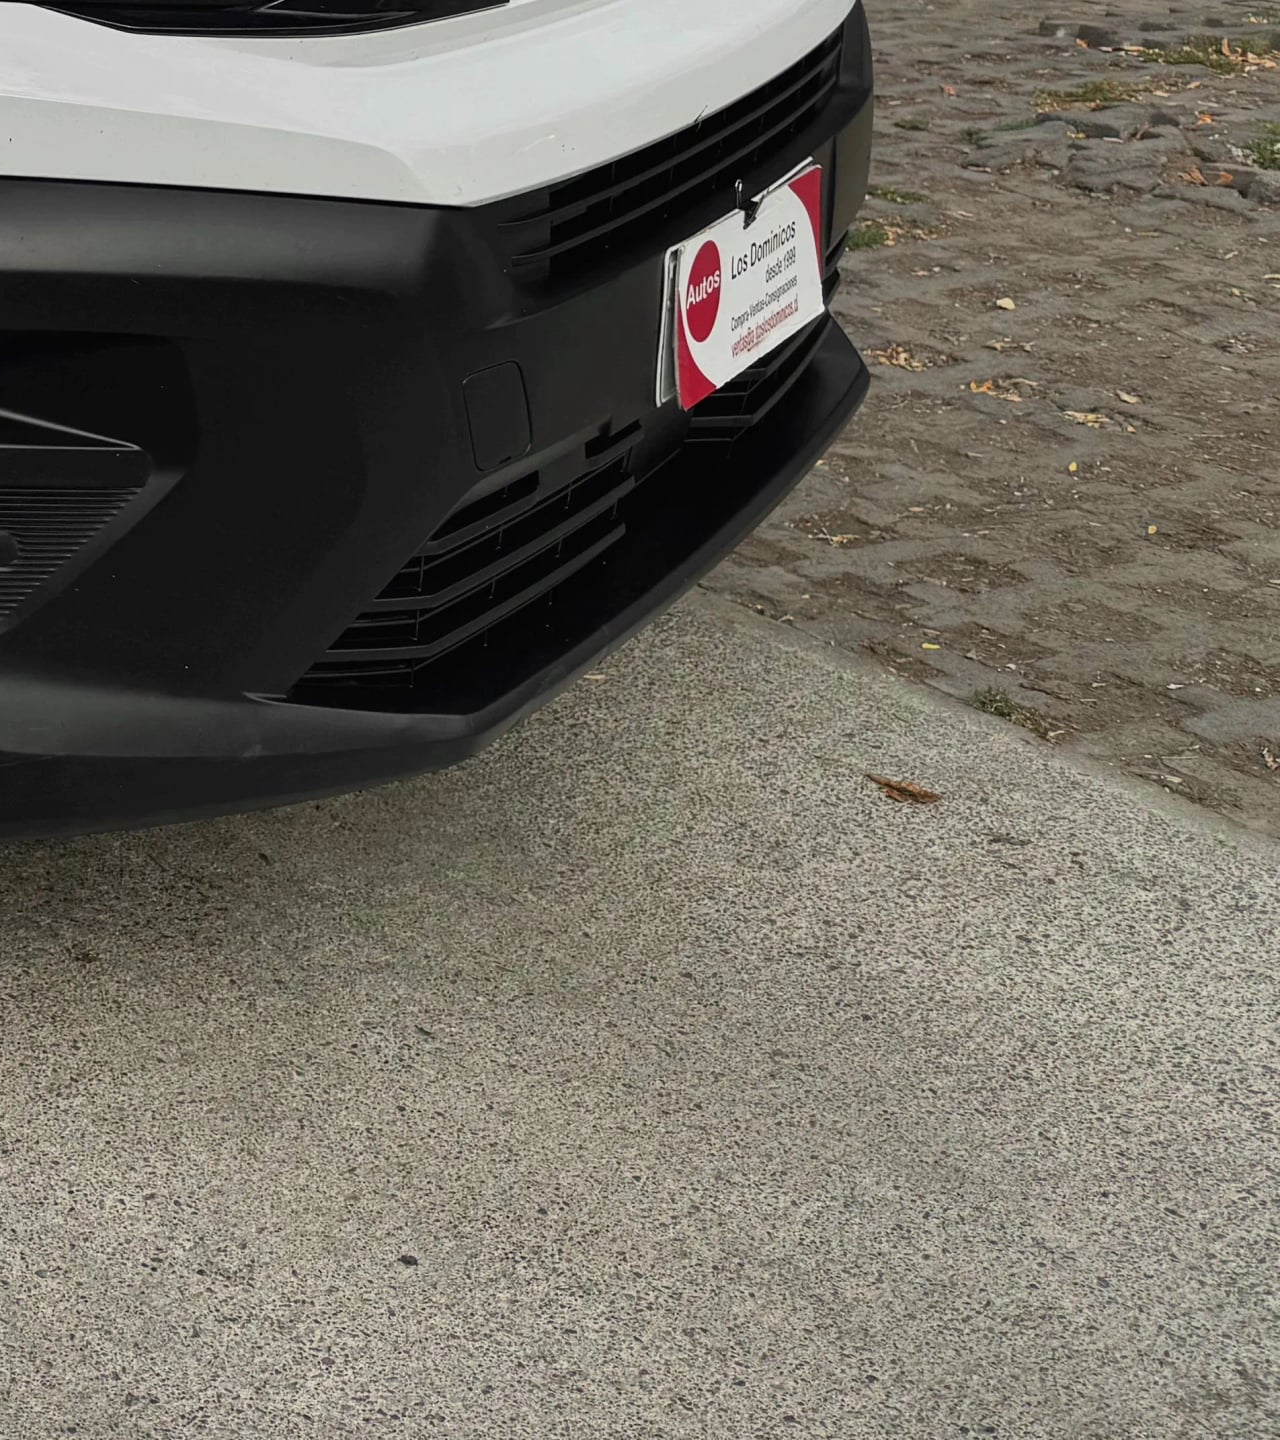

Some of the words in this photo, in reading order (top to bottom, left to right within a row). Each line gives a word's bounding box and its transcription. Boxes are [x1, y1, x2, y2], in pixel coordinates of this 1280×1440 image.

[731, 255, 748, 280] Los
[750, 221, 796, 267] Dominicos
[686, 269, 721, 310] Autos
